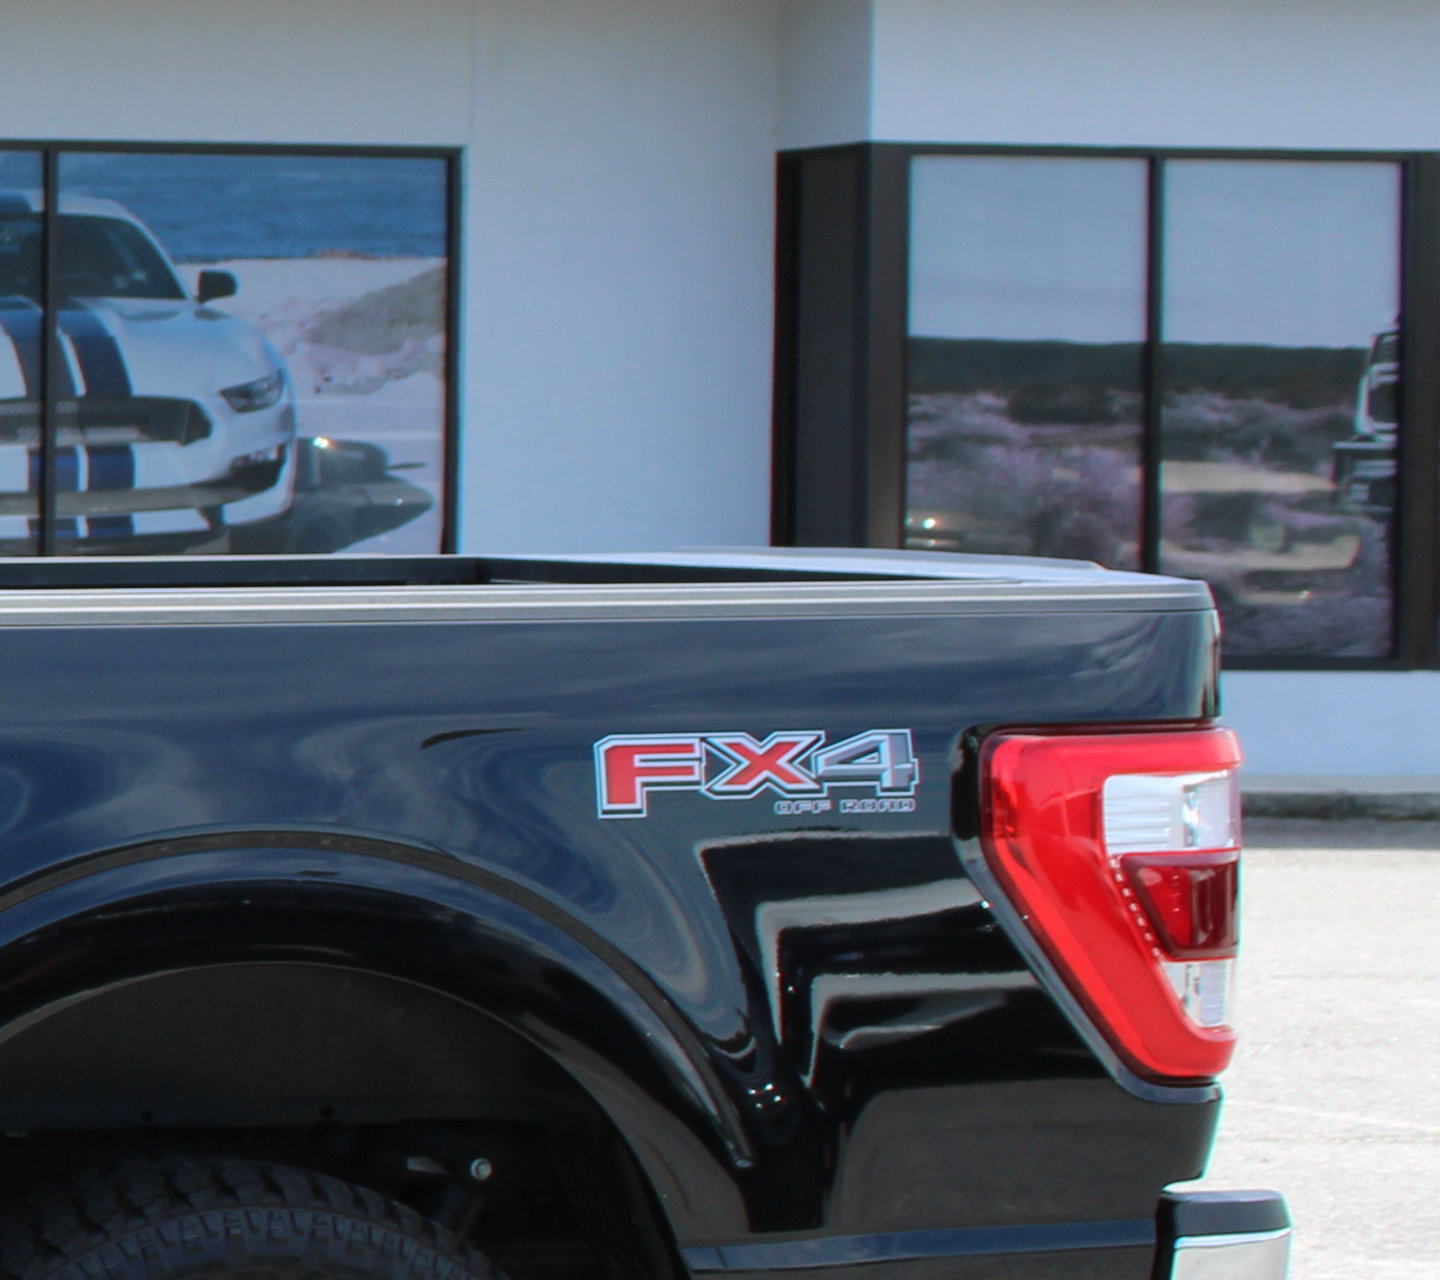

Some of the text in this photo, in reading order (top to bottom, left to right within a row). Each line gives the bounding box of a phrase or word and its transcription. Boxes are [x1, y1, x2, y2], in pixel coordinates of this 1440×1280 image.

[593, 728, 919, 819] FX4
[774, 798, 916, 815] OFF ROAD
